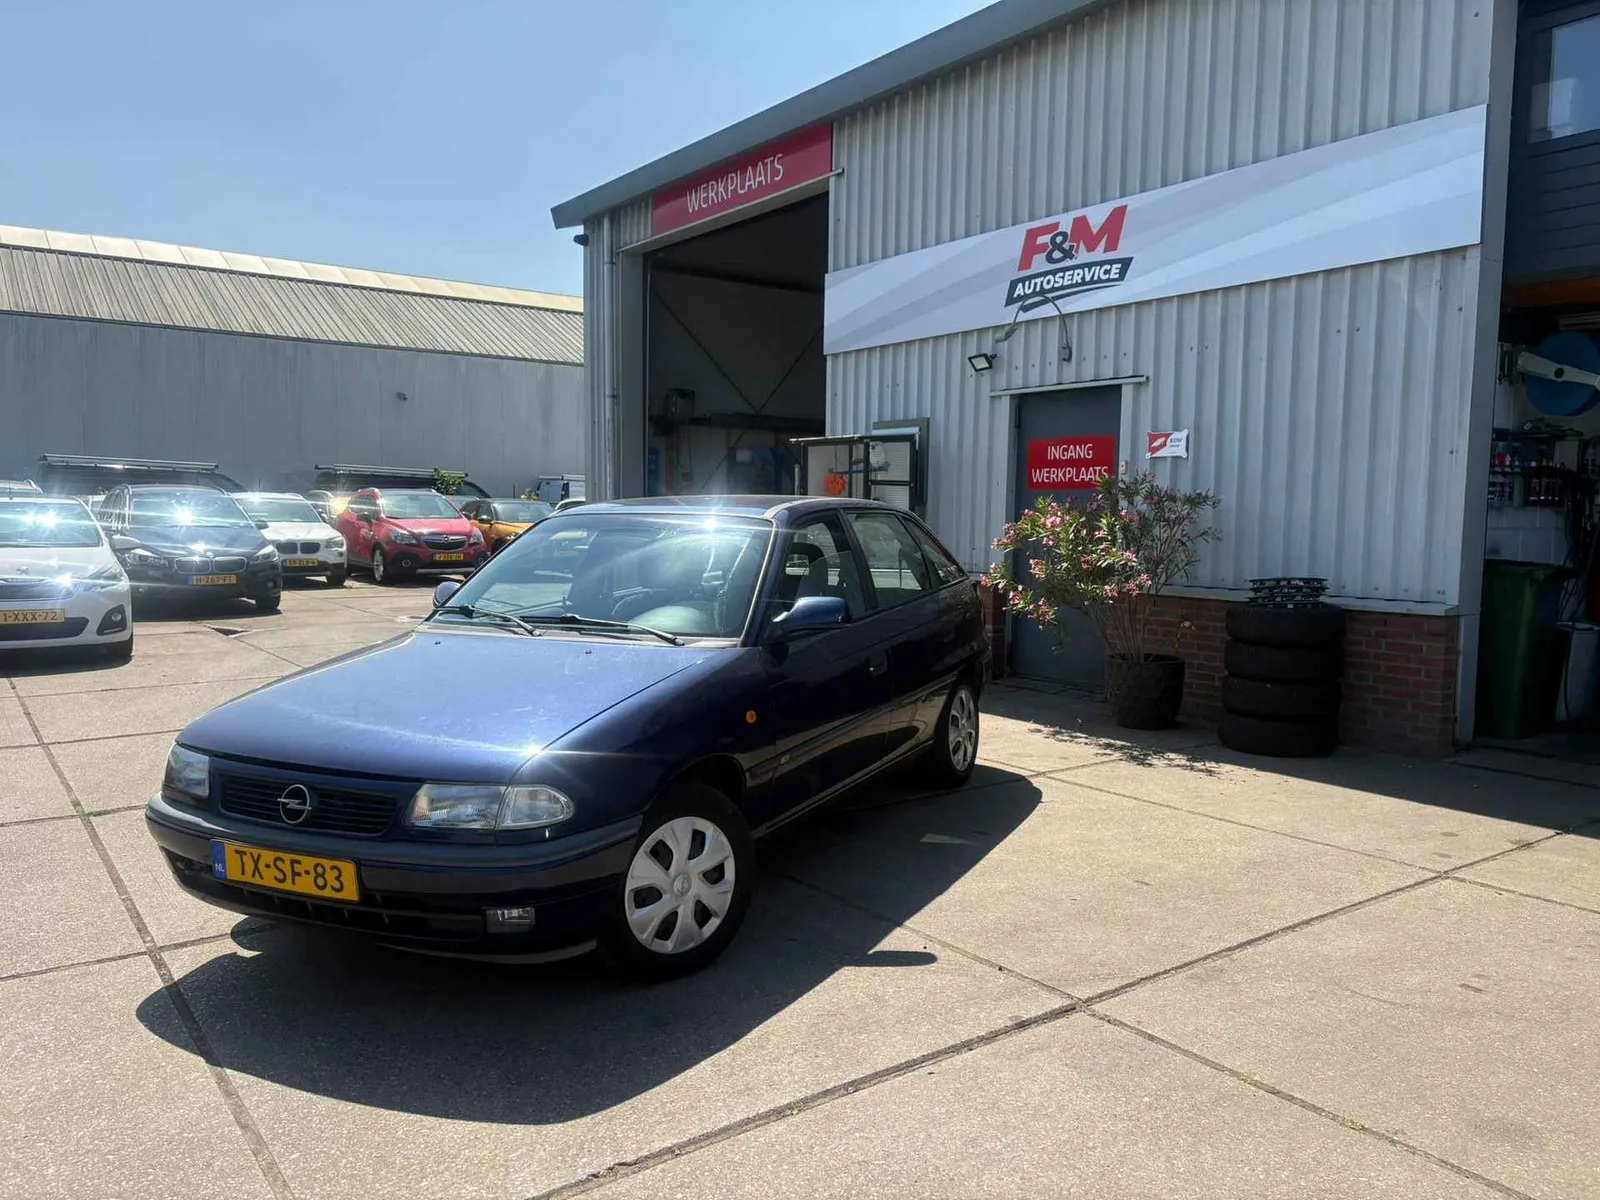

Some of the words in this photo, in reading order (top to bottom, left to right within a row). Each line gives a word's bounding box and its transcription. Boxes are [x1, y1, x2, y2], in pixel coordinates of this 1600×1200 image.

[687, 153, 784, 214] WERKPLAATS
[1017, 204, 1129, 272] F&M
[1013, 263, 1122, 298] AUTOSERVICE
[1047, 443, 1093, 461] INGANG
[1032, 465, 1109, 483] WERKPLAATS
[2, 611, 58, 623] 1-XXX-72
[214, 862, 225, 874] NL
[234, 849, 345, 893] TX-SF-83
